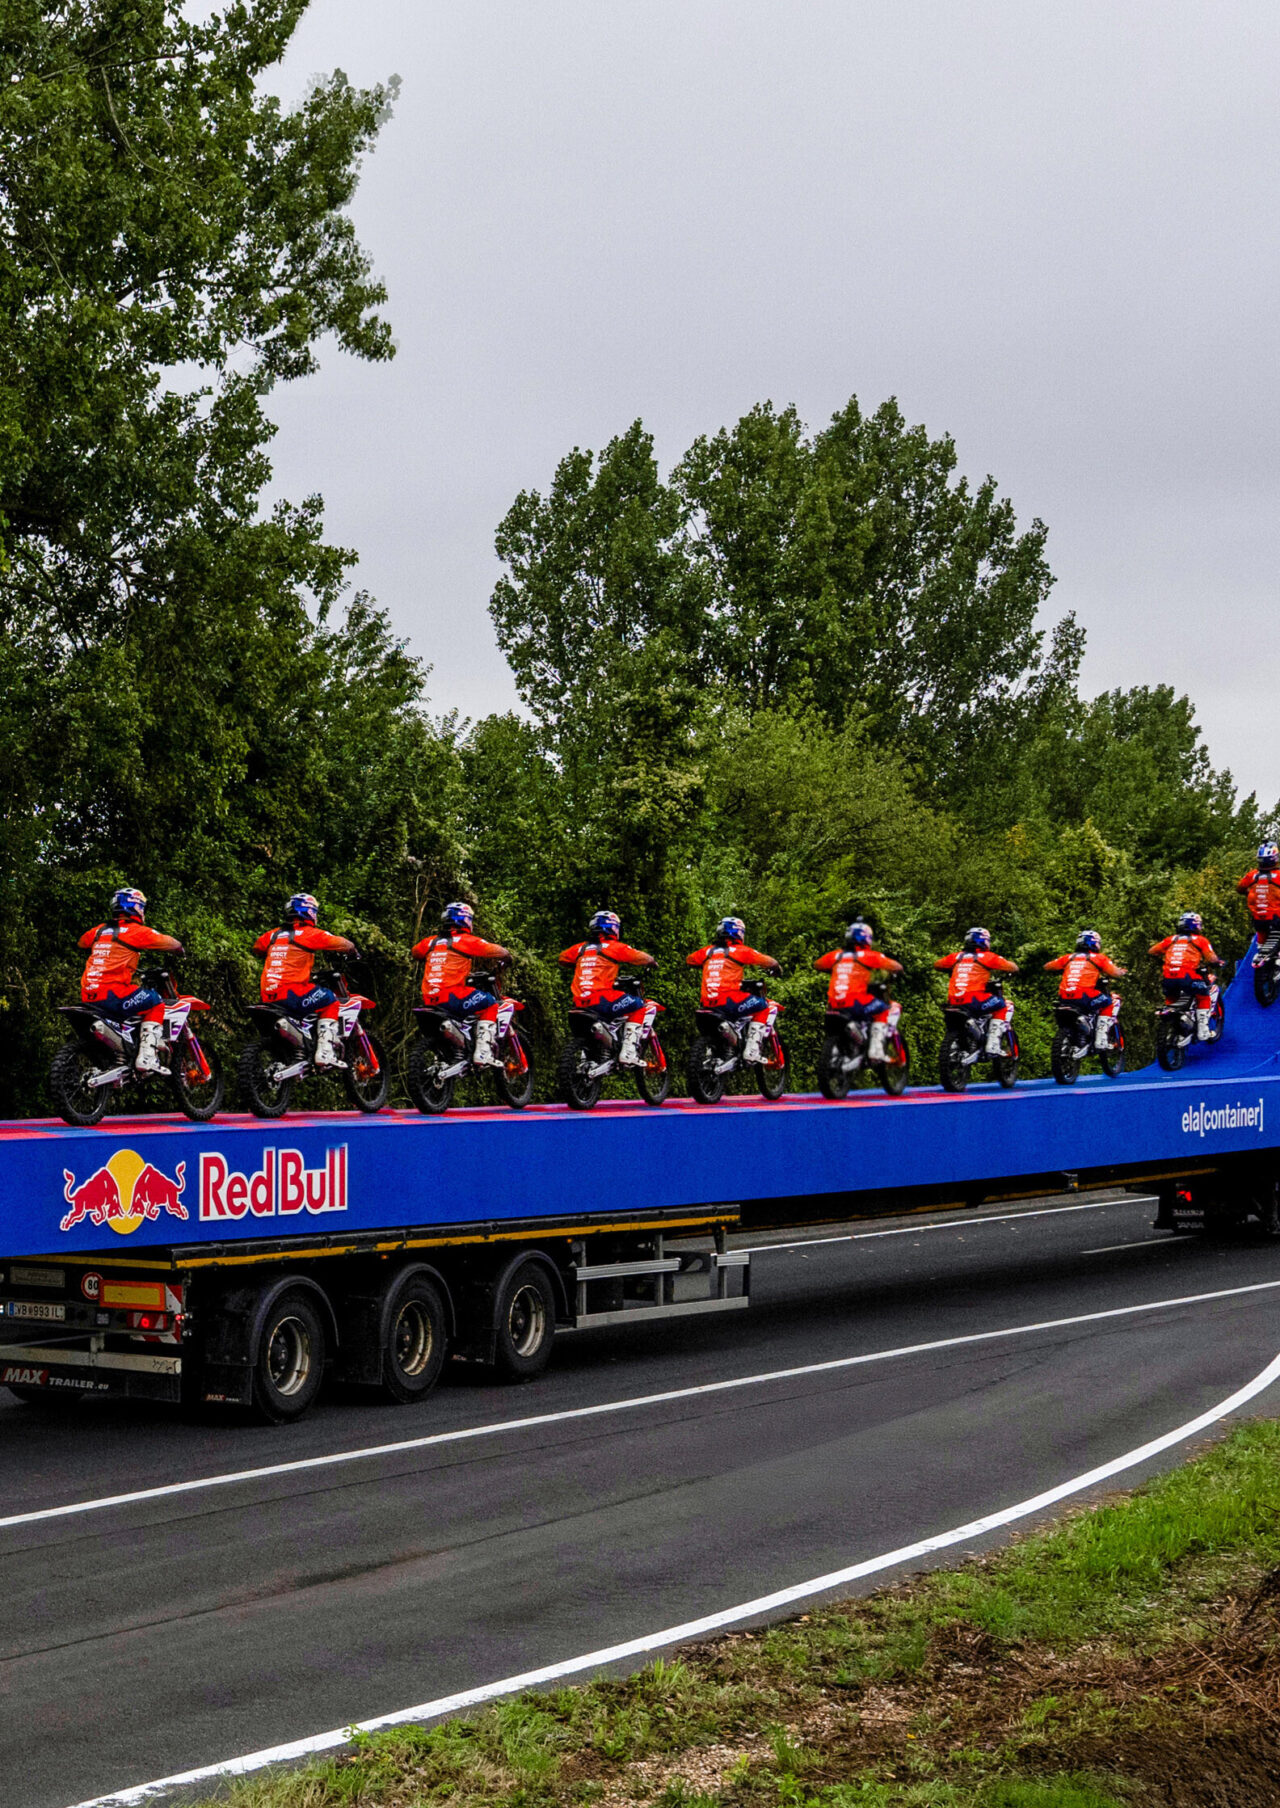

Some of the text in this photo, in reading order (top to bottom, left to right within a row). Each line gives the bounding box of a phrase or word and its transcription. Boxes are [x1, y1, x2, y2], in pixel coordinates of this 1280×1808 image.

[199, 1142, 349, 1222] Red Bull
[87, 1279, 99, 1291] 80
[33, 1305, 50, 1317] 993
[3, 1367, 44, 1385] MAX
